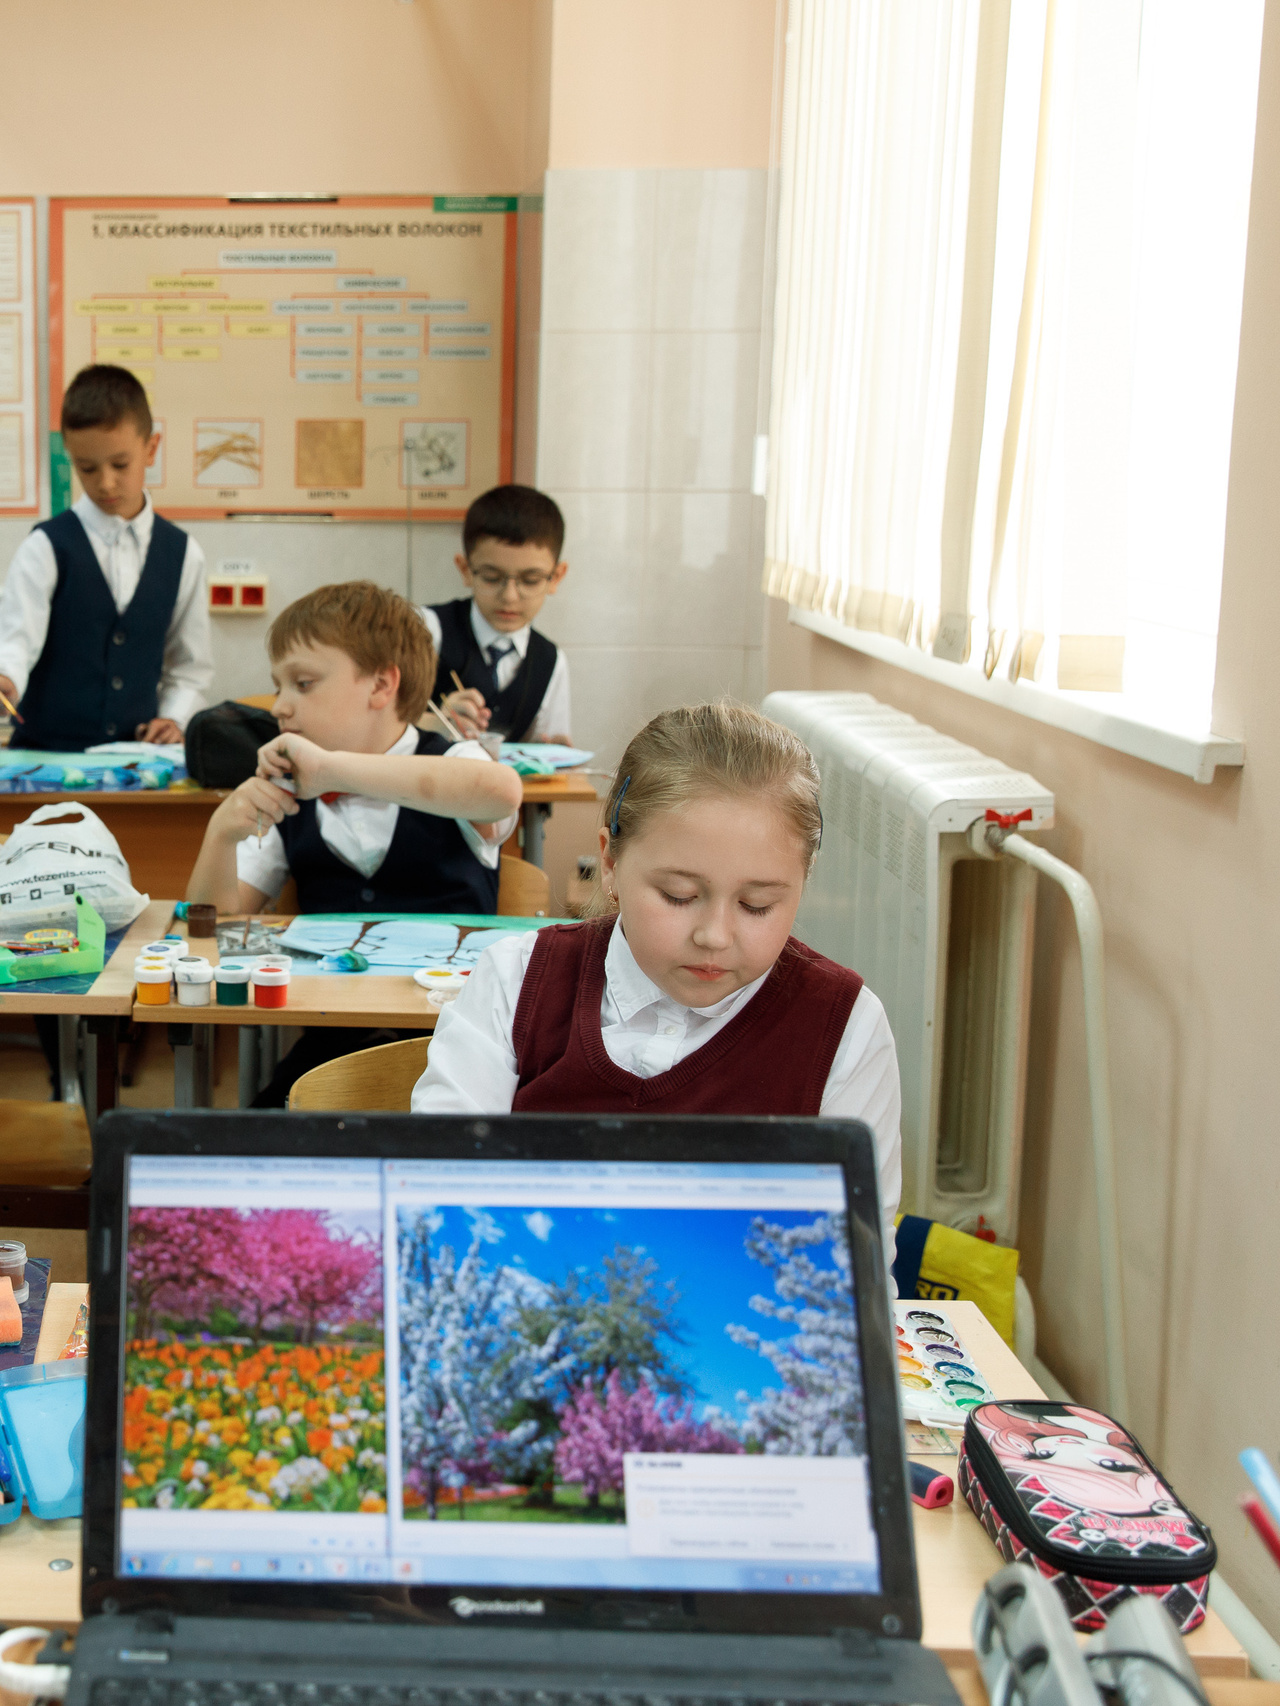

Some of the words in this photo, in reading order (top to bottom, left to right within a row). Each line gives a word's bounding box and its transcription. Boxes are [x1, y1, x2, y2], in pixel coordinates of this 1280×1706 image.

[108, 221, 265, 241] КЛАССИФИКАЦИЯ
[269, 221, 393, 239] ТЕКСТИЛЬНЫХ
[397, 220, 483, 239] ВОЛОКОН
